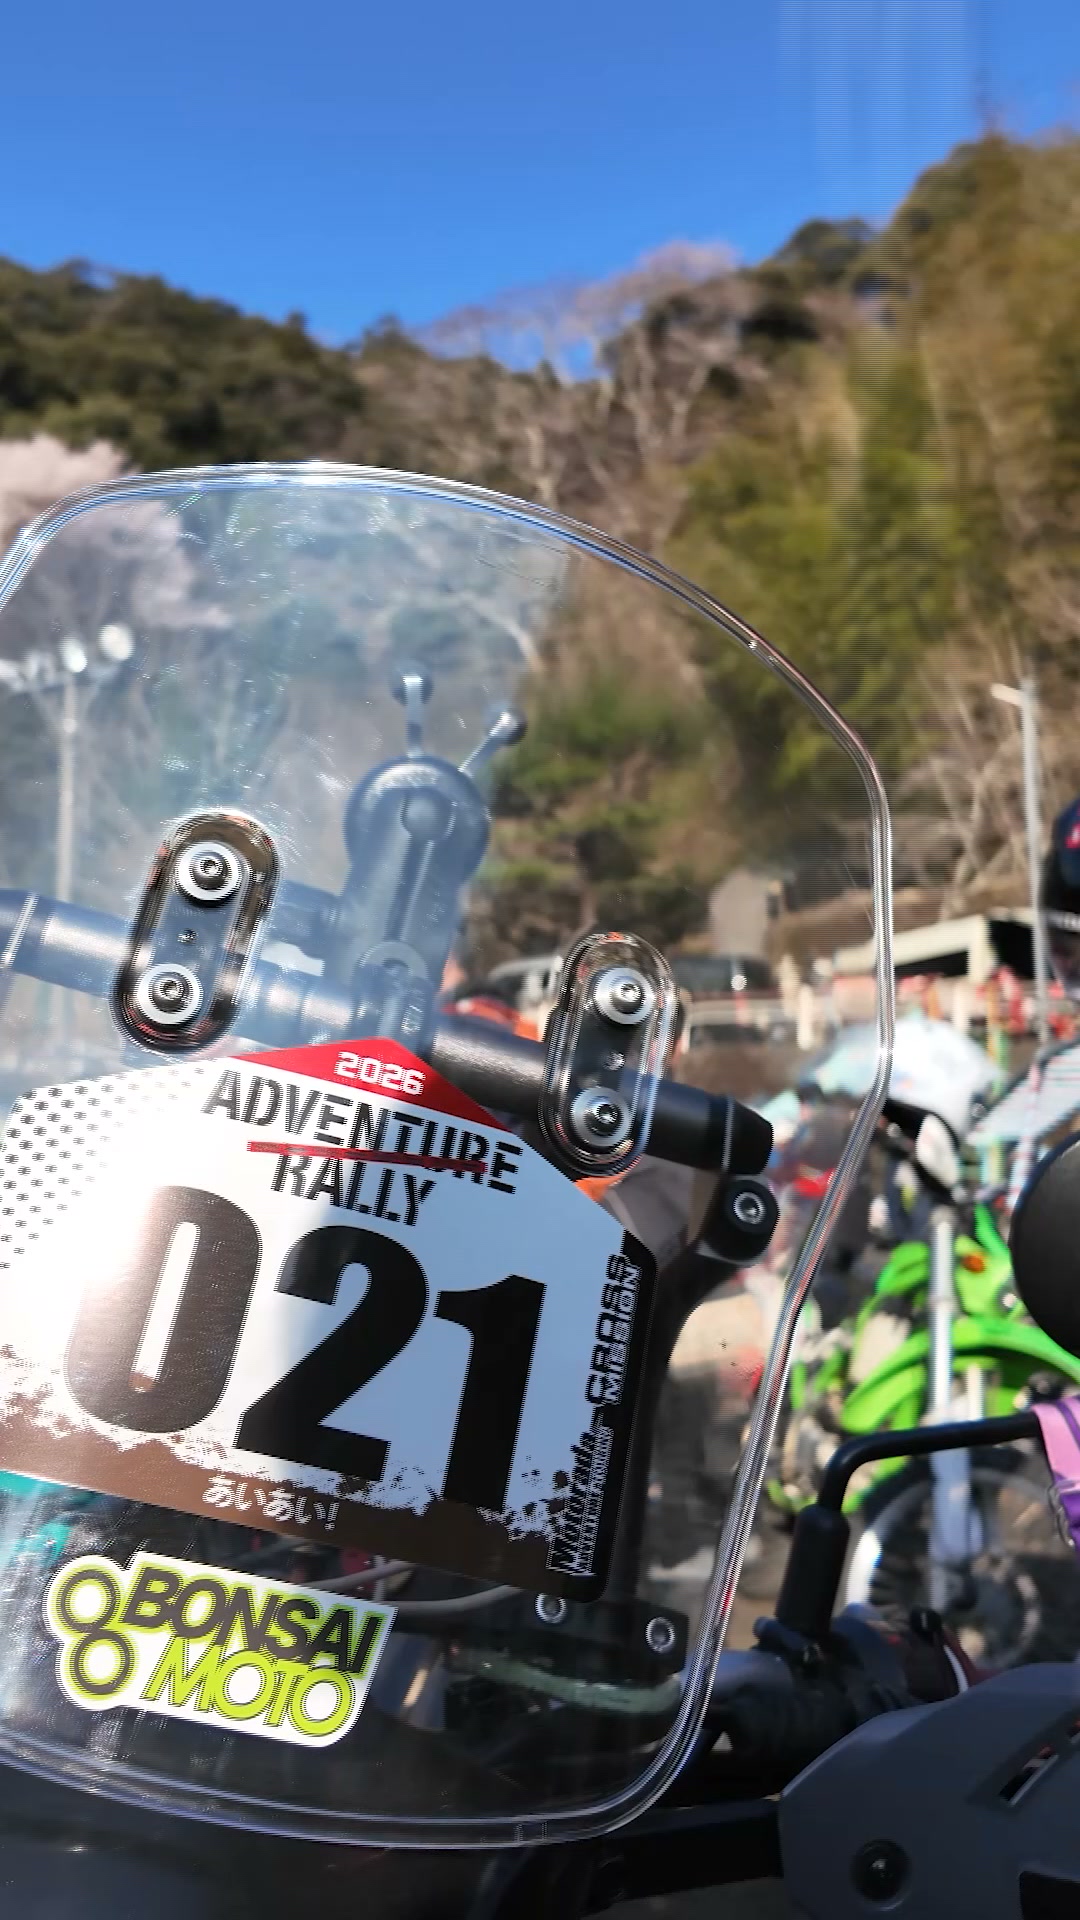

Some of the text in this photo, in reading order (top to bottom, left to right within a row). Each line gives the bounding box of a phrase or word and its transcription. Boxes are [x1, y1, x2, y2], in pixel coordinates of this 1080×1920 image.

[201, 1069, 523, 1195] ADVENTURE
[334, 1051, 425, 1096] 2026
[271, 1150, 436, 1227] RALLY
[66, 1186, 546, 1511] 021
[585, 1254, 628, 1406] CROSS
[604, 1264, 642, 1405] MISSION
[548, 1430, 600, 1573] Motorada
[121, 1566, 385, 1674] BONSAI
[140, 1636, 356, 1737] MOTO
